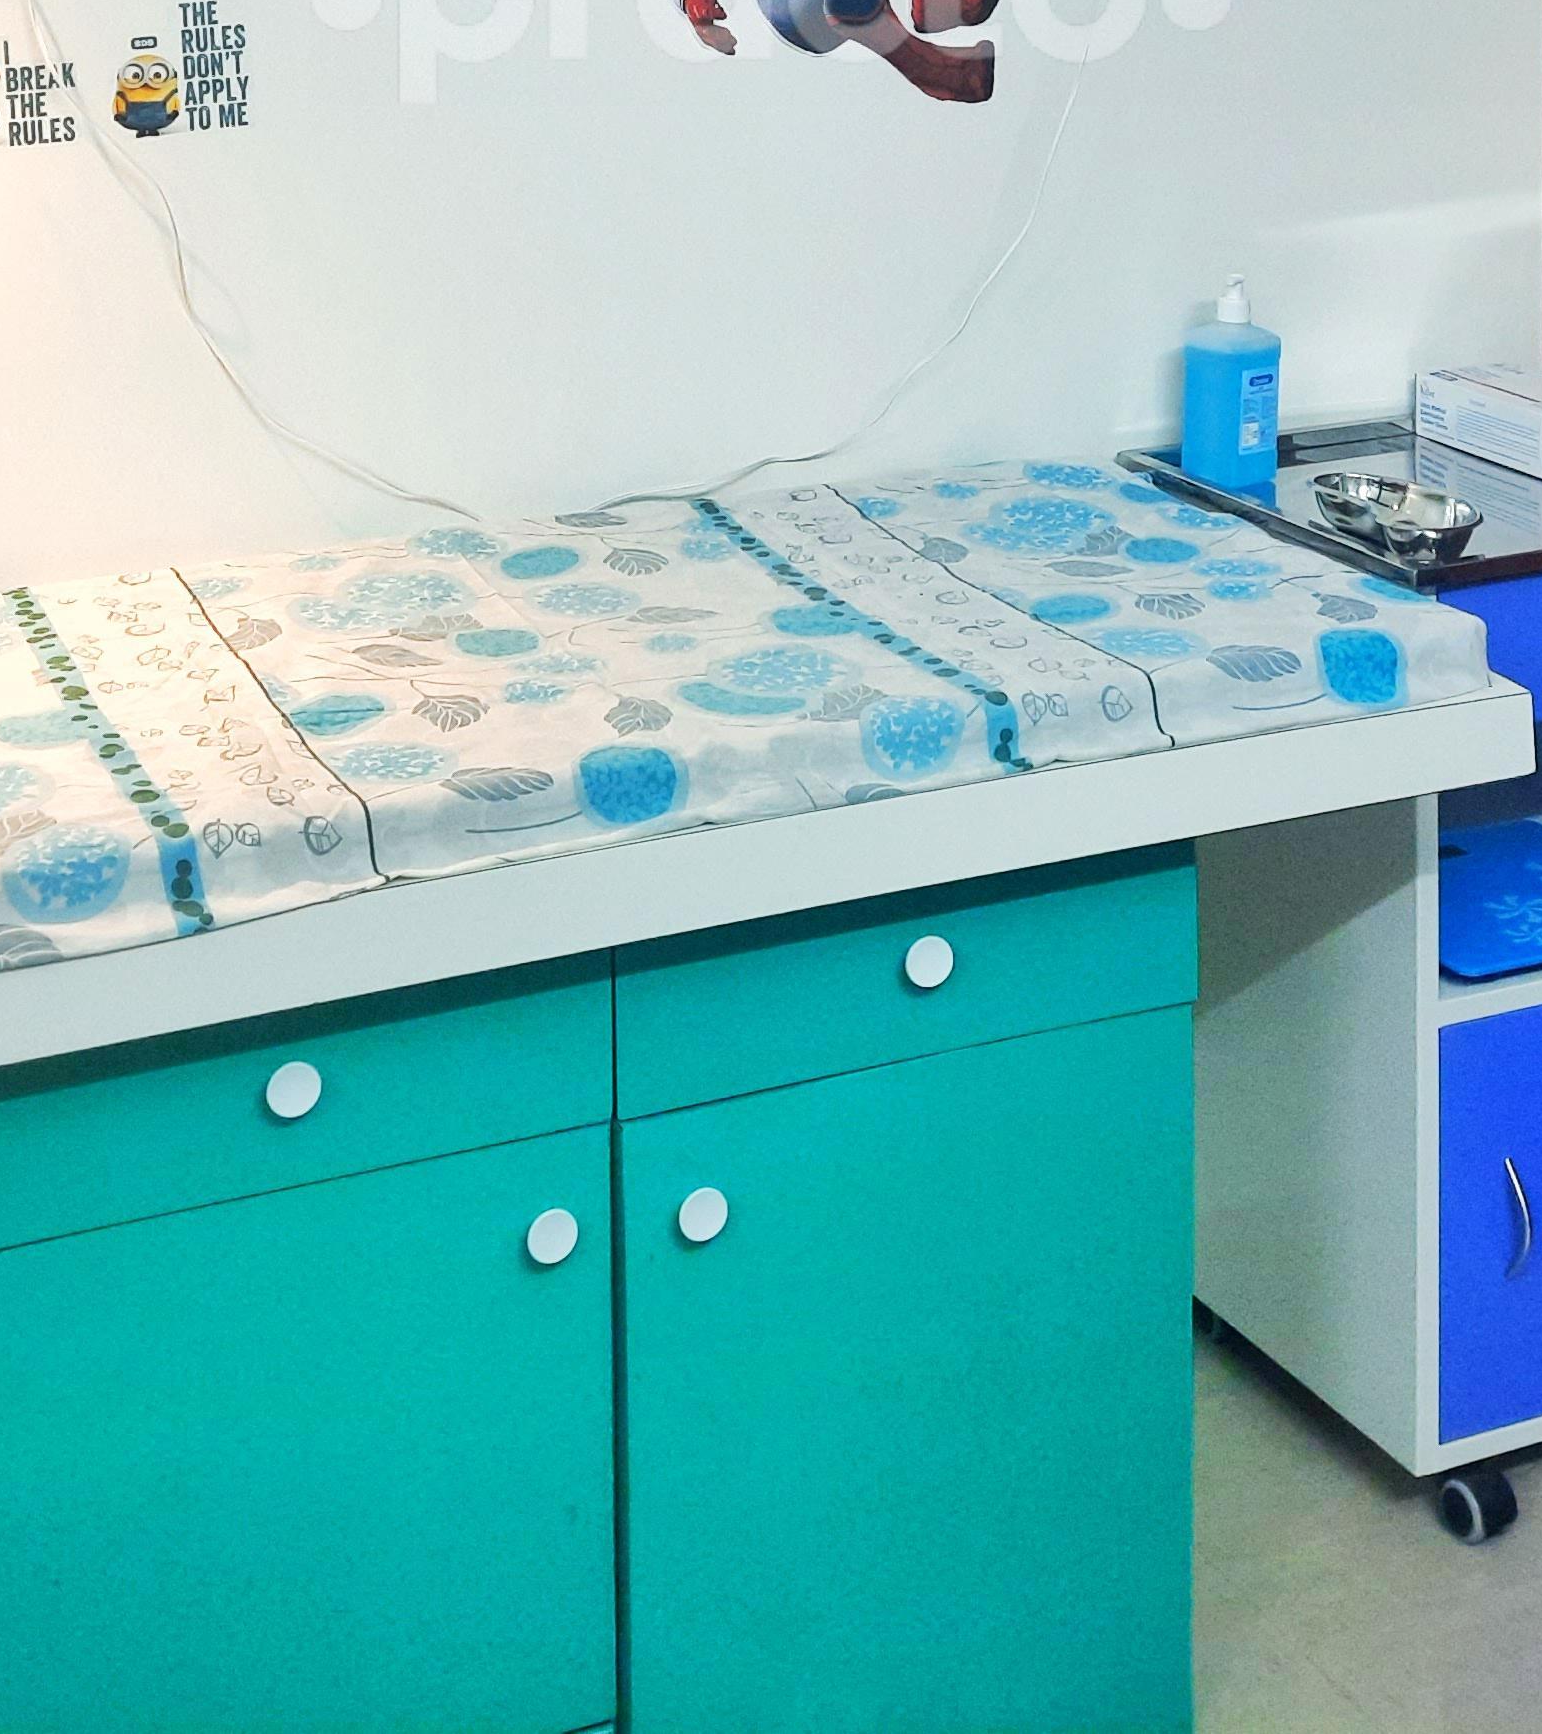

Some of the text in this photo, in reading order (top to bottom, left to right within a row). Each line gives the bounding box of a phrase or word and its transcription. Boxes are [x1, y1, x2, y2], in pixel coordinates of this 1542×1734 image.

[178, 0, 219, 27] THE
[3, 40, 10, 65] I
[181, 24, 246, 53] RULES
[5, 62, 76, 93] BREAK
[182, 50, 244, 80] DON'T
[184, 75, 249, 106] APPLY
[5, 92, 48, 120] THE
[185, 102, 249, 132] TO ME
[8, 116, 76, 147] RULES
